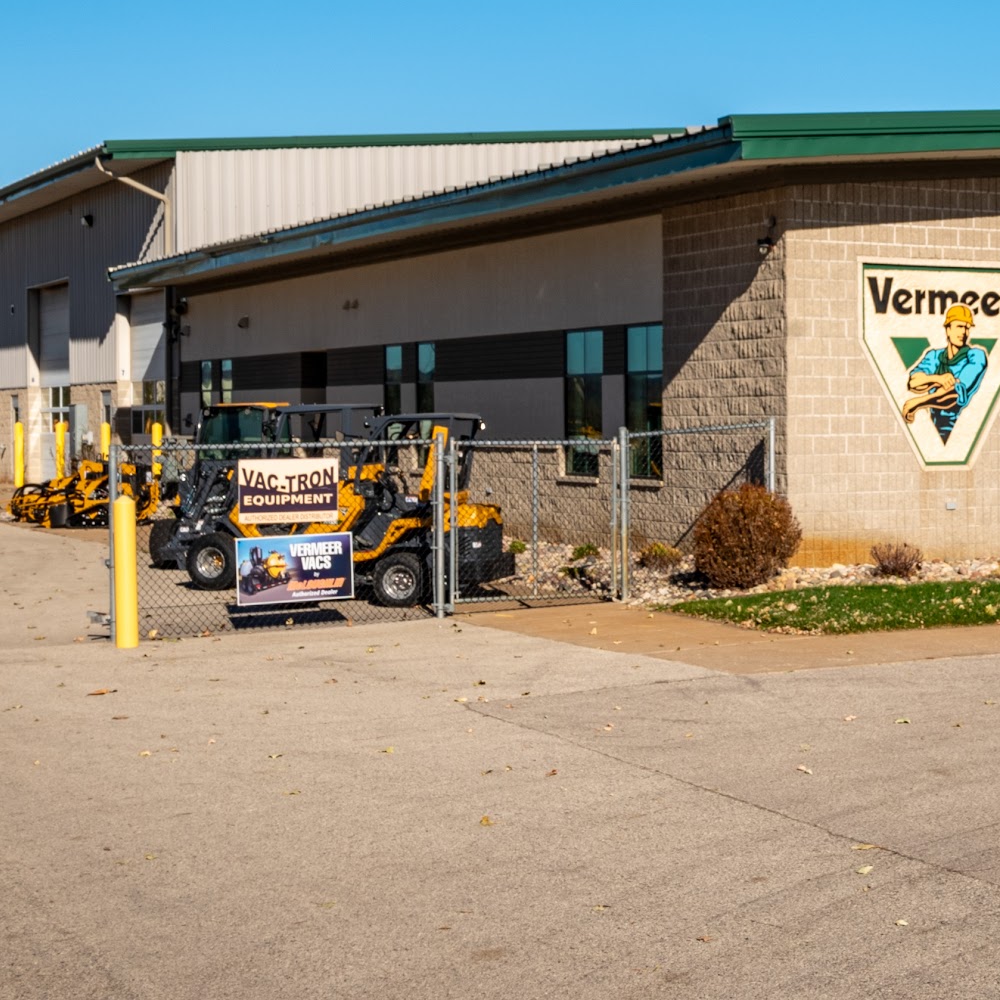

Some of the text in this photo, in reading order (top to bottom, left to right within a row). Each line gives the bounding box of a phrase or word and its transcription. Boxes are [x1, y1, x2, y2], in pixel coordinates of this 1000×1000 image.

[242, 466, 334, 493] VAC-TRON
[243, 493, 334, 507] EQUIPMENT
[244, 514, 279, 522] AUTHORIZED
[278, 513, 300, 521] DEALER
[289, 541, 343, 557] VERMEER
[301, 556, 332, 571] VACS
[292, 590, 321, 598] Authorized
